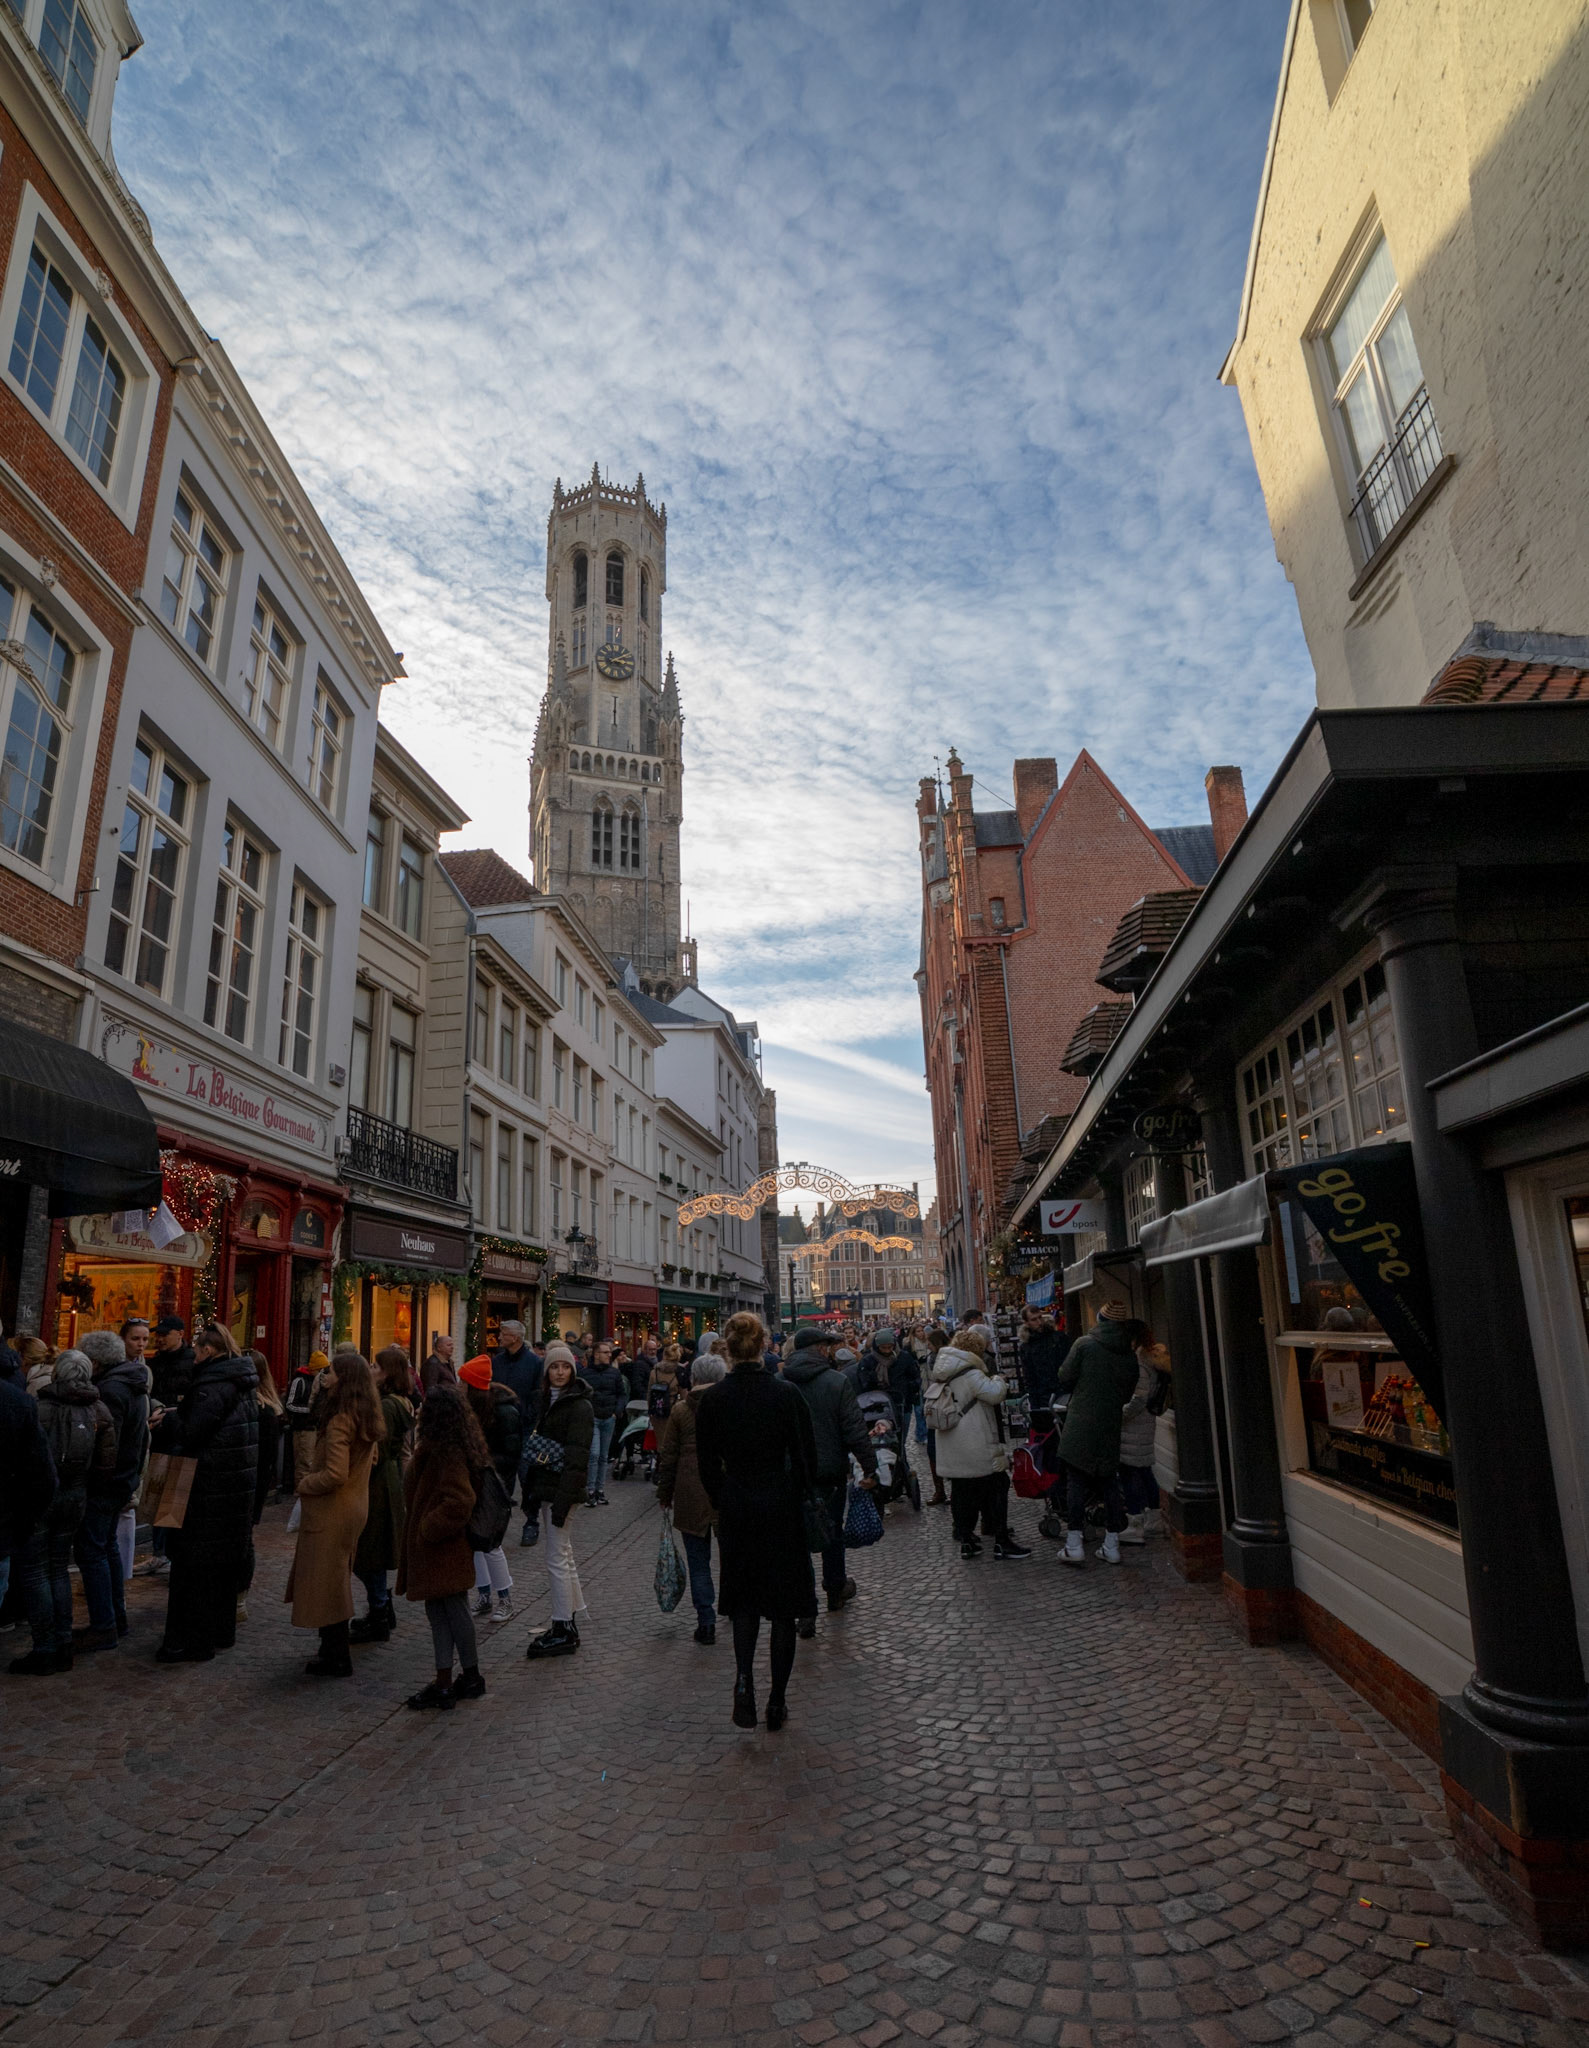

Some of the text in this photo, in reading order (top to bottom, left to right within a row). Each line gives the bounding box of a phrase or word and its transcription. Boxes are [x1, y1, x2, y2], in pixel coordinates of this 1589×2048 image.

[185, 1063, 316, 1144] La Belgique Gourmande
[1072, 1220, 1098, 1229] bpost
[1297, 1167, 1412, 1284] go.fre
[400, 1232, 435, 1254] Neuhaus
[1019, 1245, 1059, 1255] TABACCO
[22, 1304, 32, 1319] 16
[1402, 1469, 1435, 1499] Belgian
